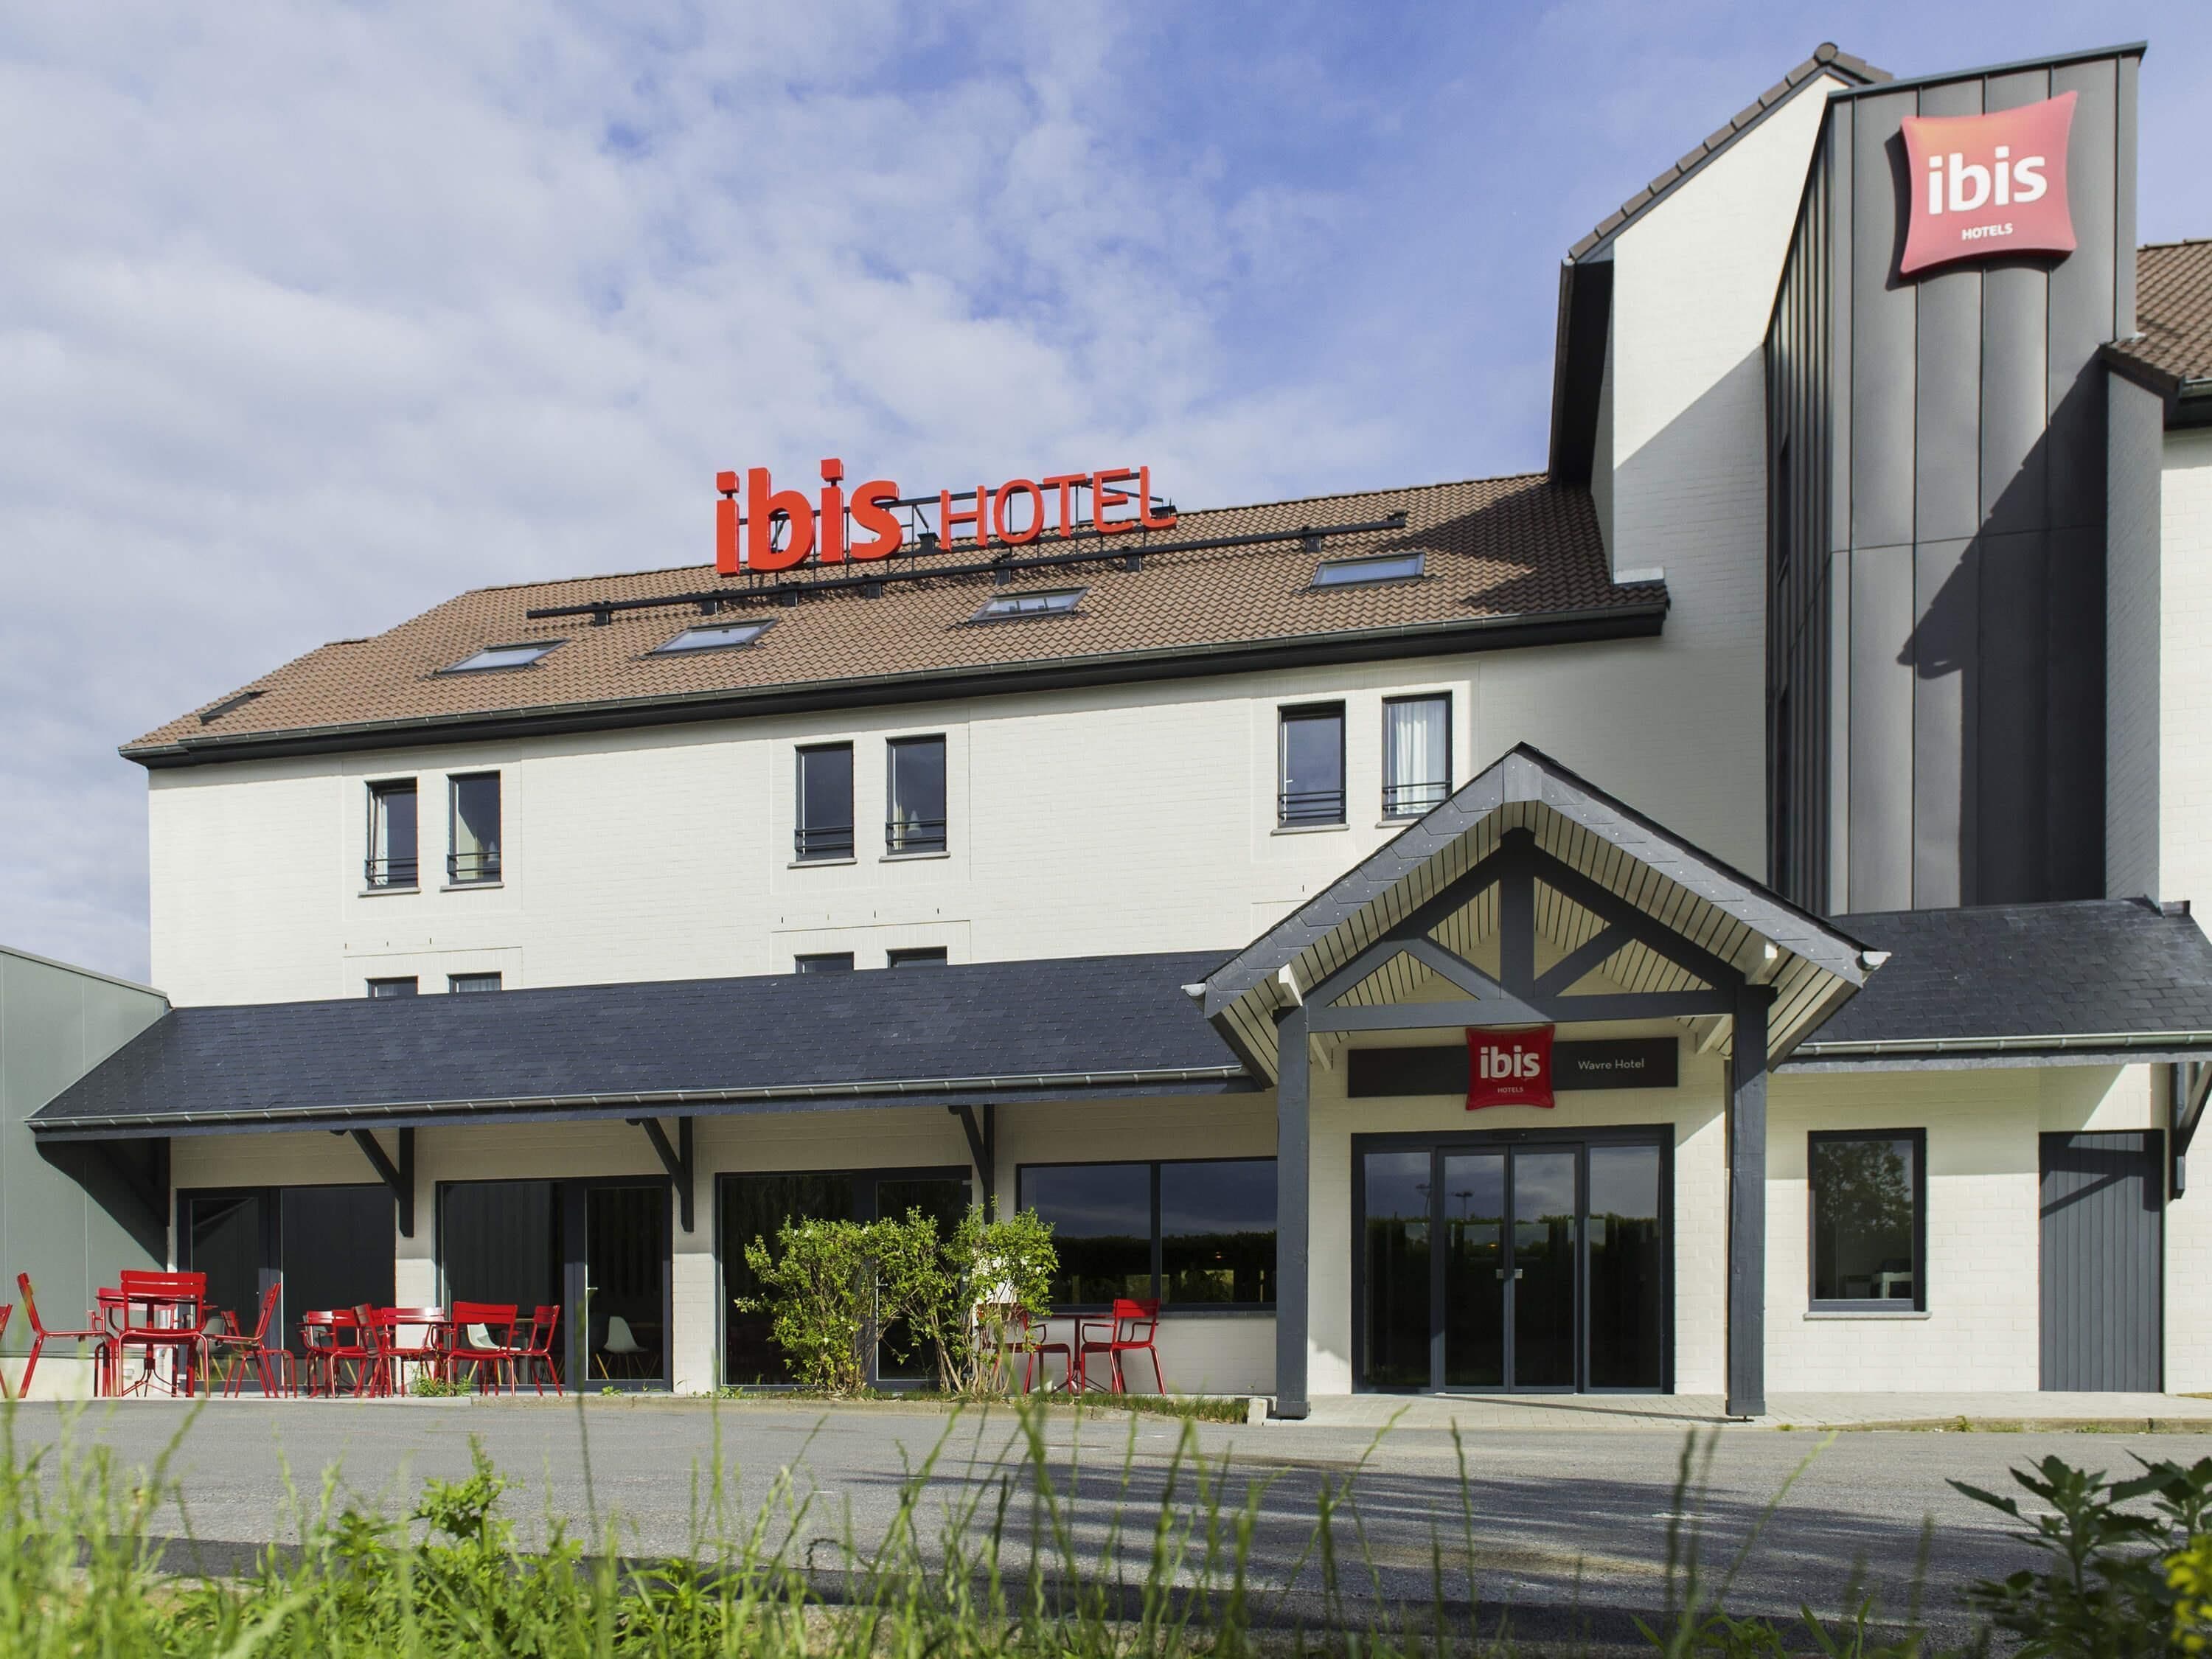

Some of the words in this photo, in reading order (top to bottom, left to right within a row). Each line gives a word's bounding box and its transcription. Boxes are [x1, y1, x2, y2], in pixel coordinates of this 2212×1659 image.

[1928, 145, 2048, 215] ibis
[1961, 223, 2014, 240] HOTELS
[716, 458, 903, 576] ibis
[939, 466, 1177, 552] HOTEL
[1480, 1046, 1541, 1079] ibis
[1578, 1060, 1613, 1070] Wavre
[1614, 1058, 1645, 1068] Hotel
